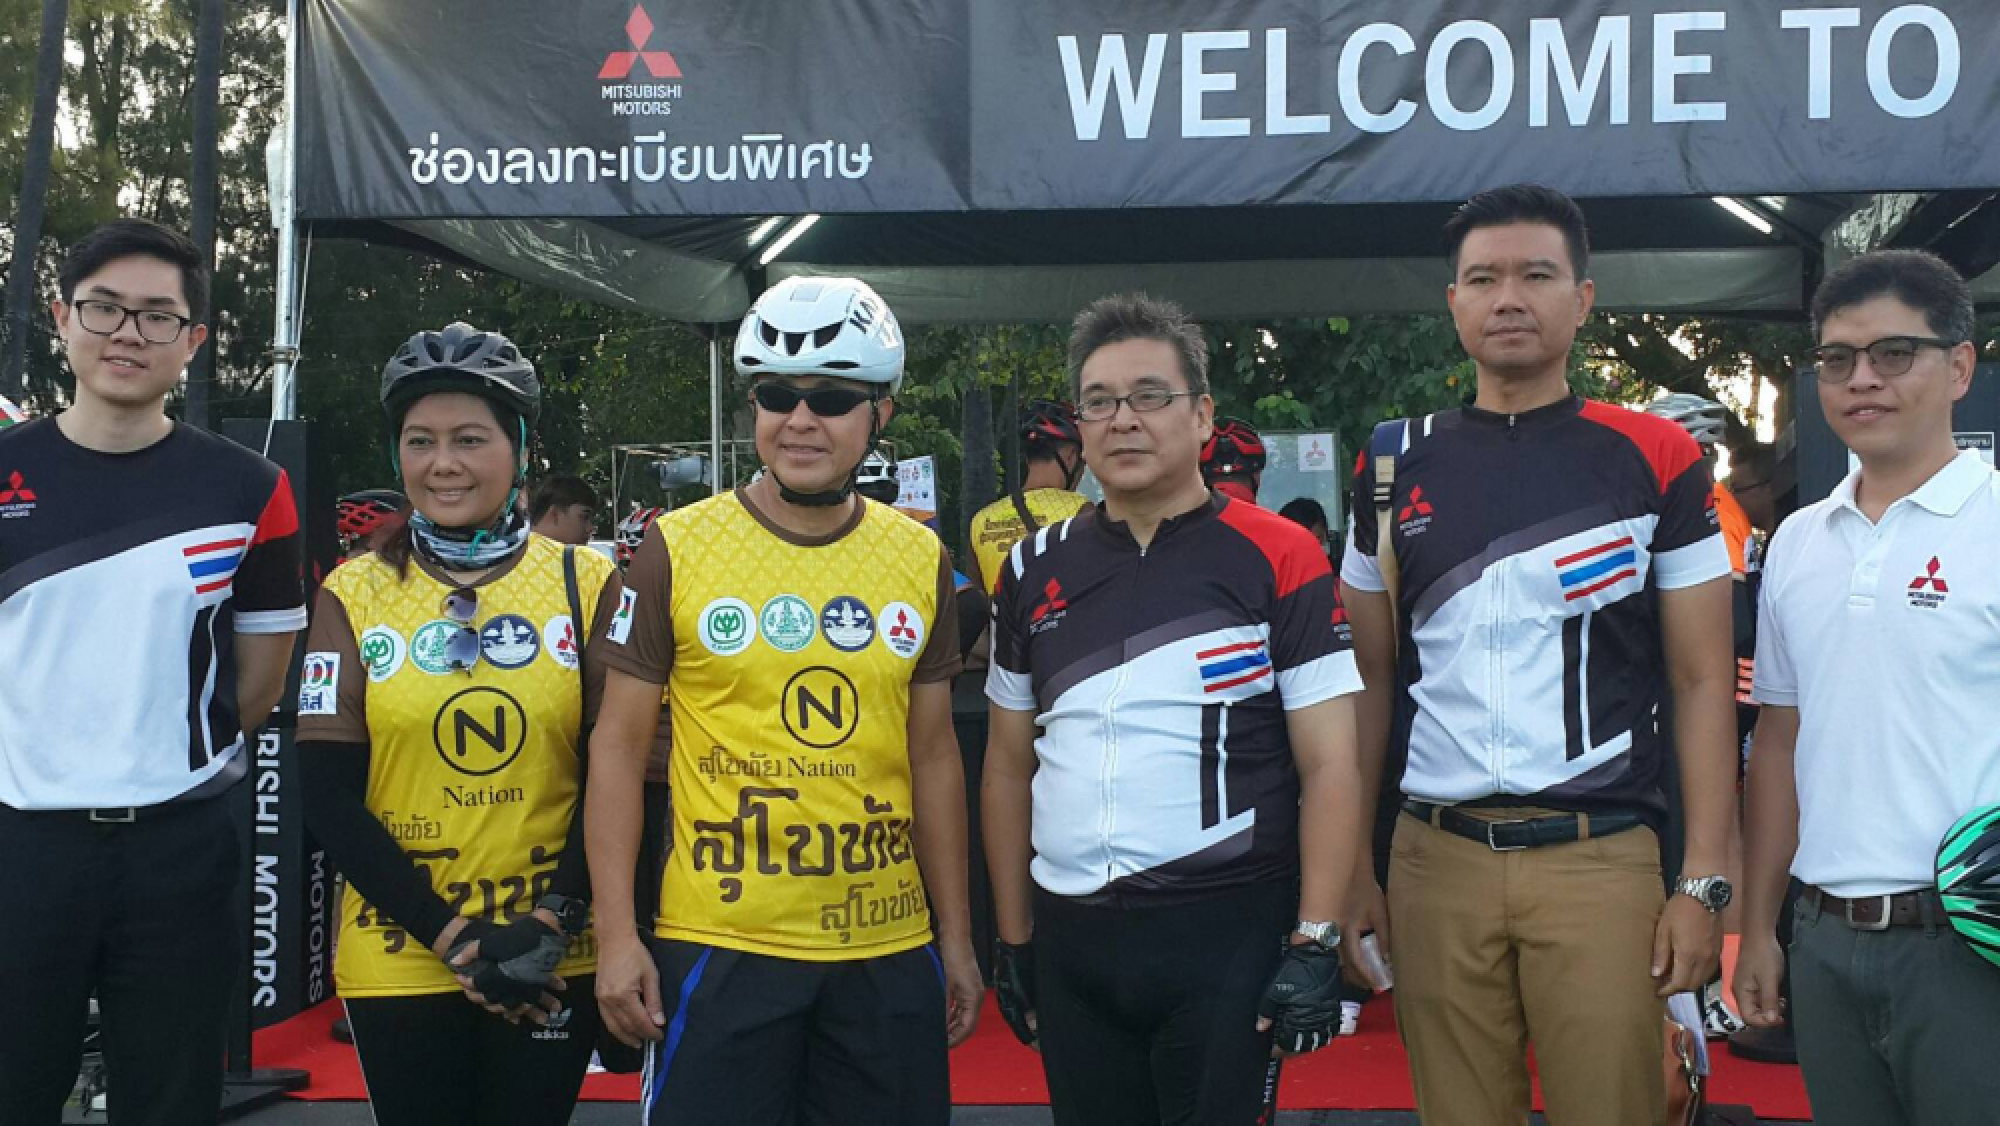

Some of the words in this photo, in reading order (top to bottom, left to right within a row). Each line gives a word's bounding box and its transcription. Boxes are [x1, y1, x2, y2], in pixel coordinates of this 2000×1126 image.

[601, 85, 682, 99] MITSUBISHI
[1056, 10, 1727, 142] WELCOME
[1780, 3, 1961, 120] TO
[612, 101, 671, 116] MOTORS
[408, 130, 873, 186] ช่องลงทะเบียนพิเศษ
[453, 705, 507, 757] N
[797, 685, 843, 731] N
[787, 755, 857, 778] Nation
[443, 785, 523, 808] Nation
[251, 855, 279, 1008] MOTORS
[309, 850, 325, 1003] MOTORS
